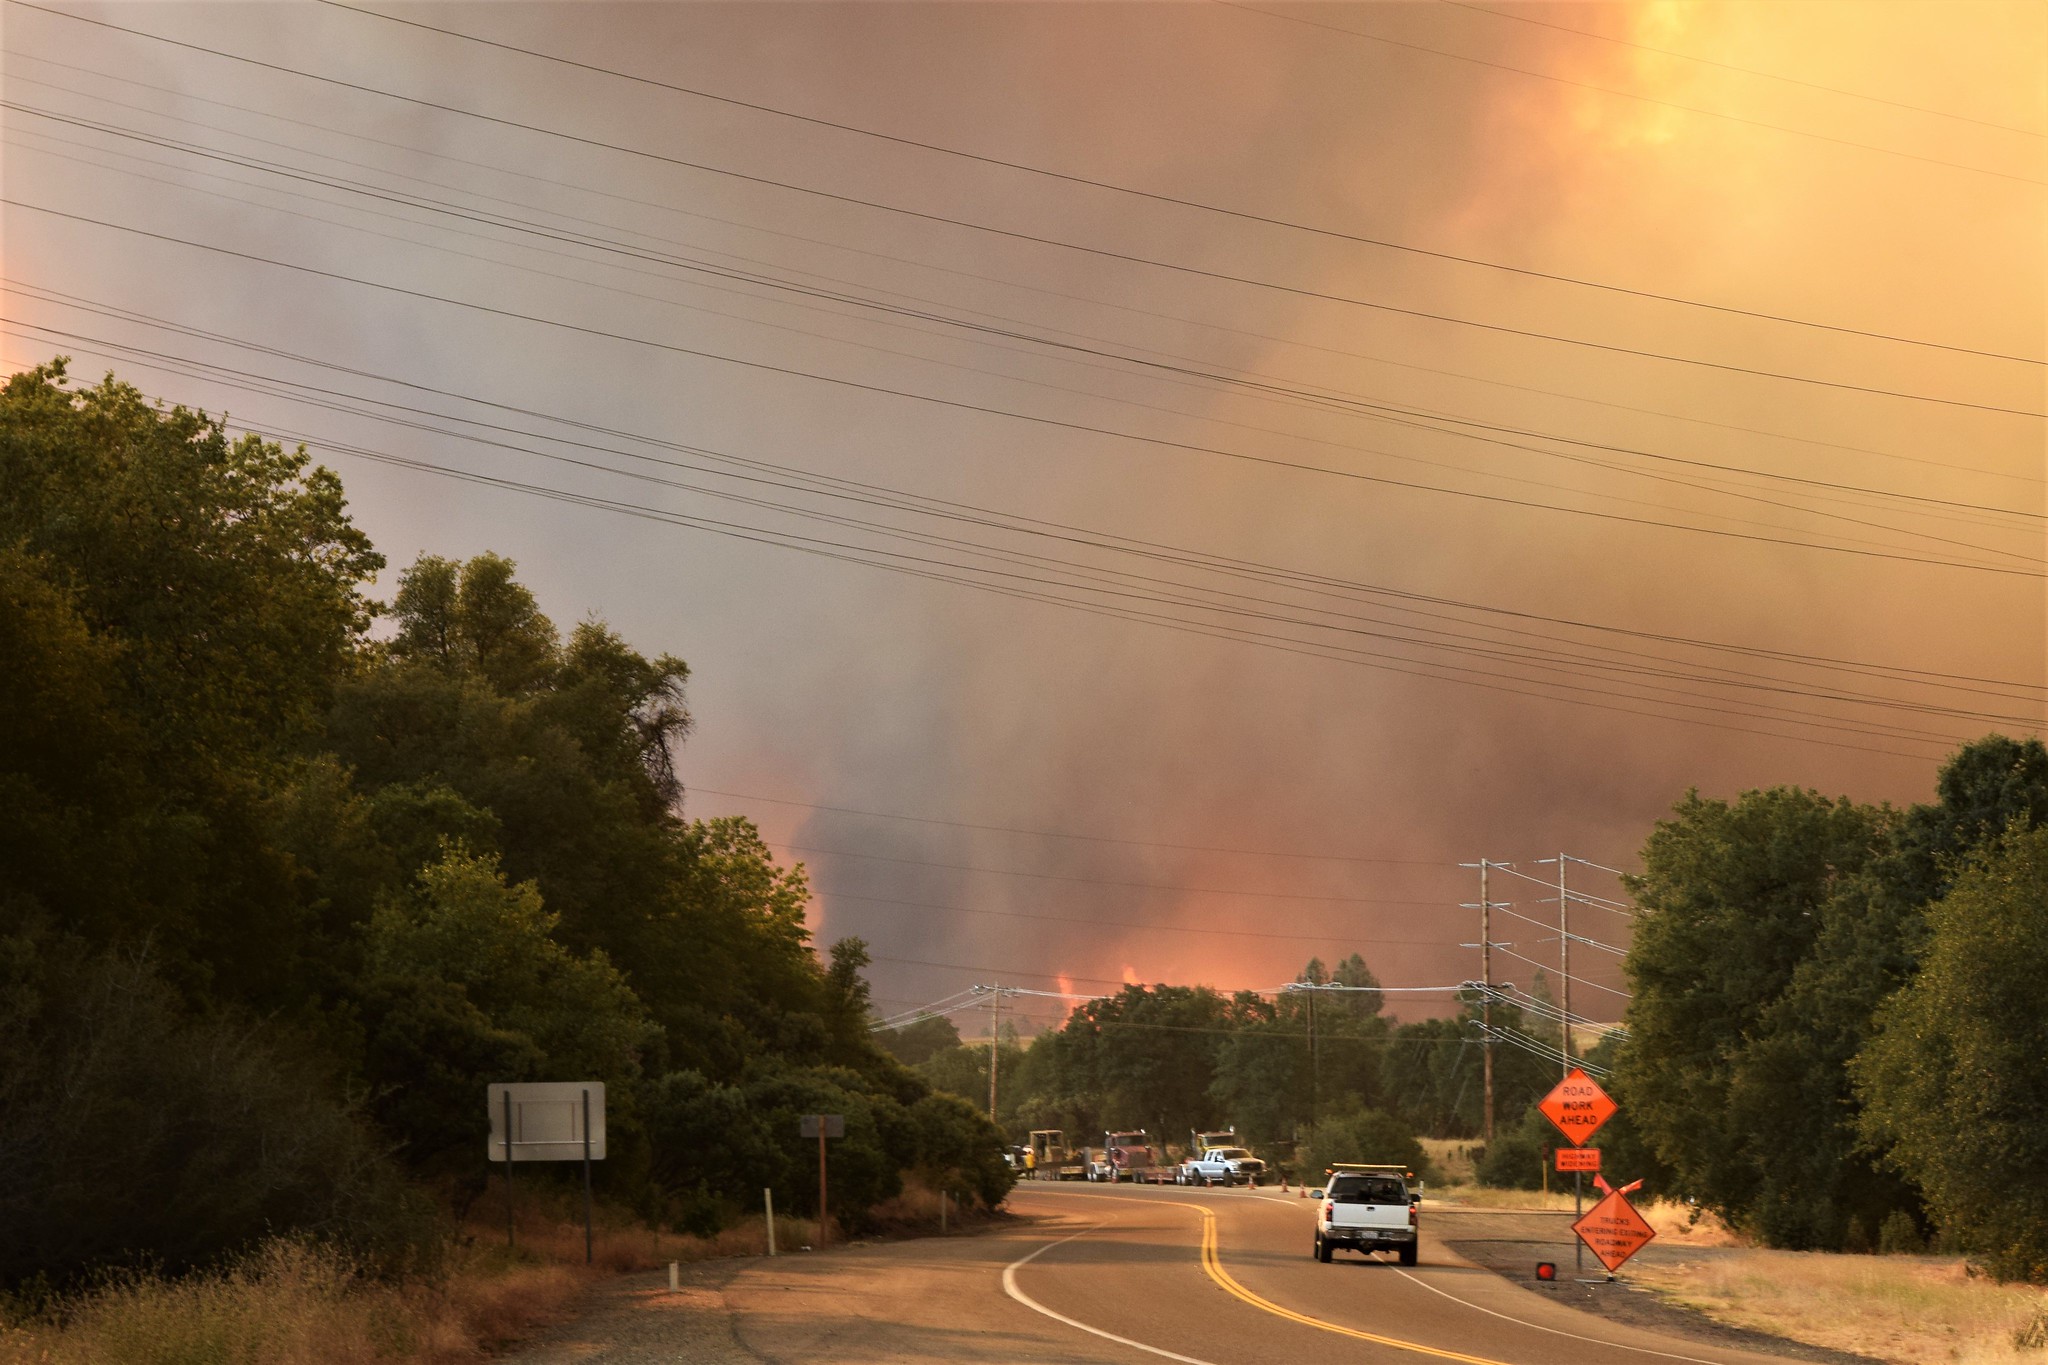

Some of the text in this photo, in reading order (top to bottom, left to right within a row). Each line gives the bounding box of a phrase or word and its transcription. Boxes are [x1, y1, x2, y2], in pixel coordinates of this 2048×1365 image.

[1563, 1086, 1593, 1096] ROAD
[1562, 1101, 1593, 1111] WORK
[1560, 1115, 1597, 1125] AHEAD
[1600, 1217, 1630, 1225] TRUCKS
[1581, 1227, 1648, 1238] ENTERING EXITING
[1595, 1238, 1633, 1247] ROADWAY
[1600, 1250, 1626, 1258] AHEAD
